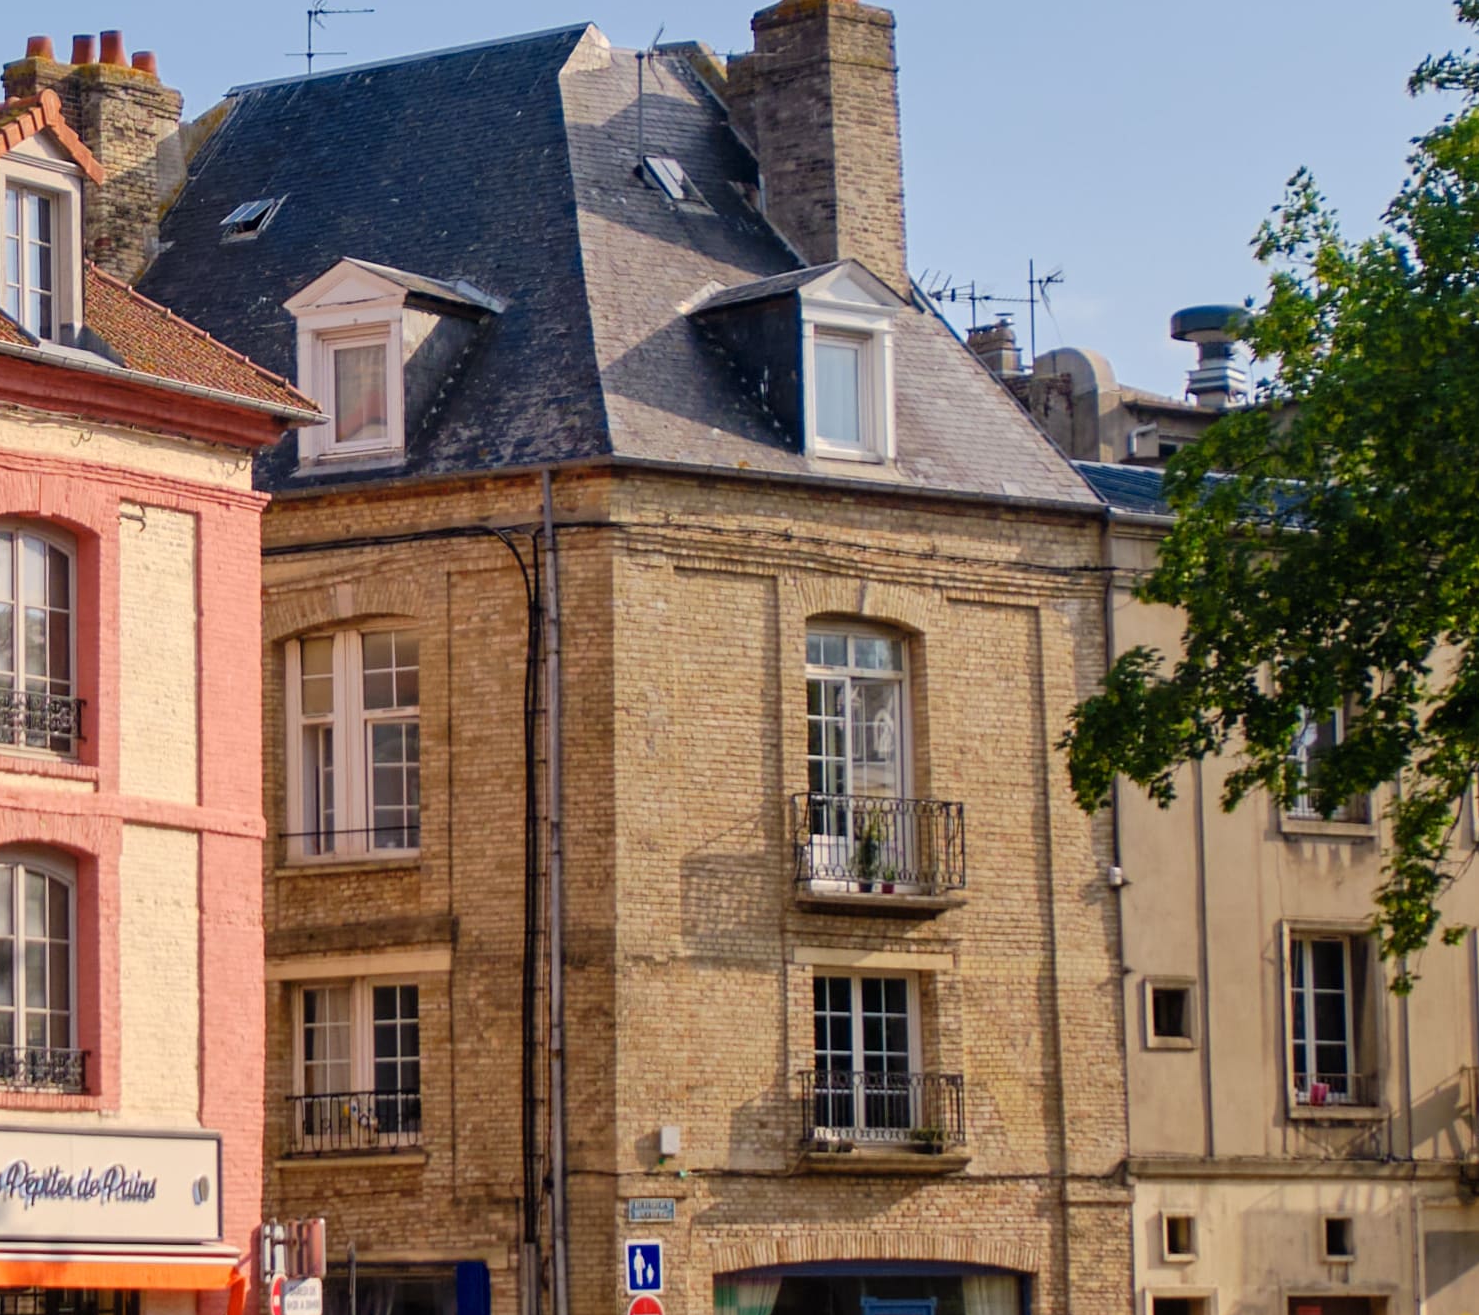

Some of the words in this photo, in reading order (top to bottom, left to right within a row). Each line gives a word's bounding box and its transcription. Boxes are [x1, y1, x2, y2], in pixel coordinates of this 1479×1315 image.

[5, 1159, 73, 1206] Pépites
[76, 1166, 101, 1199] de
[102, 1164, 157, 1202] Pains
